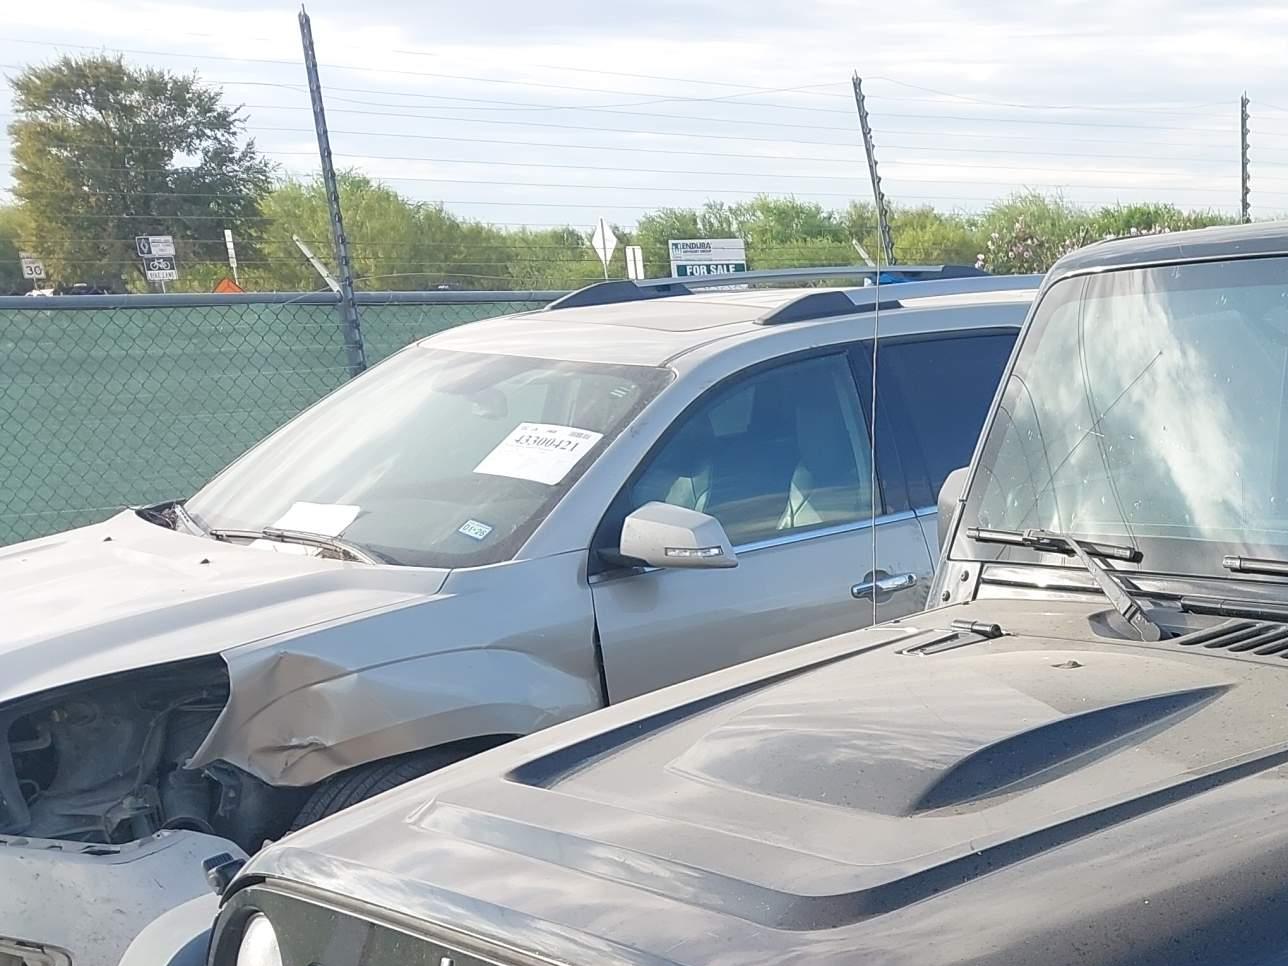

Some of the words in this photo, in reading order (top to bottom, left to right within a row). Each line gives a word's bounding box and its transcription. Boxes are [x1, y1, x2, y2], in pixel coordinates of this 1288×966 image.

[26, 266, 42, 275] 30
[687, 265, 706, 276] FOR
[710, 264, 736, 274] SALE
[515, 434, 579, 452] 43300421
